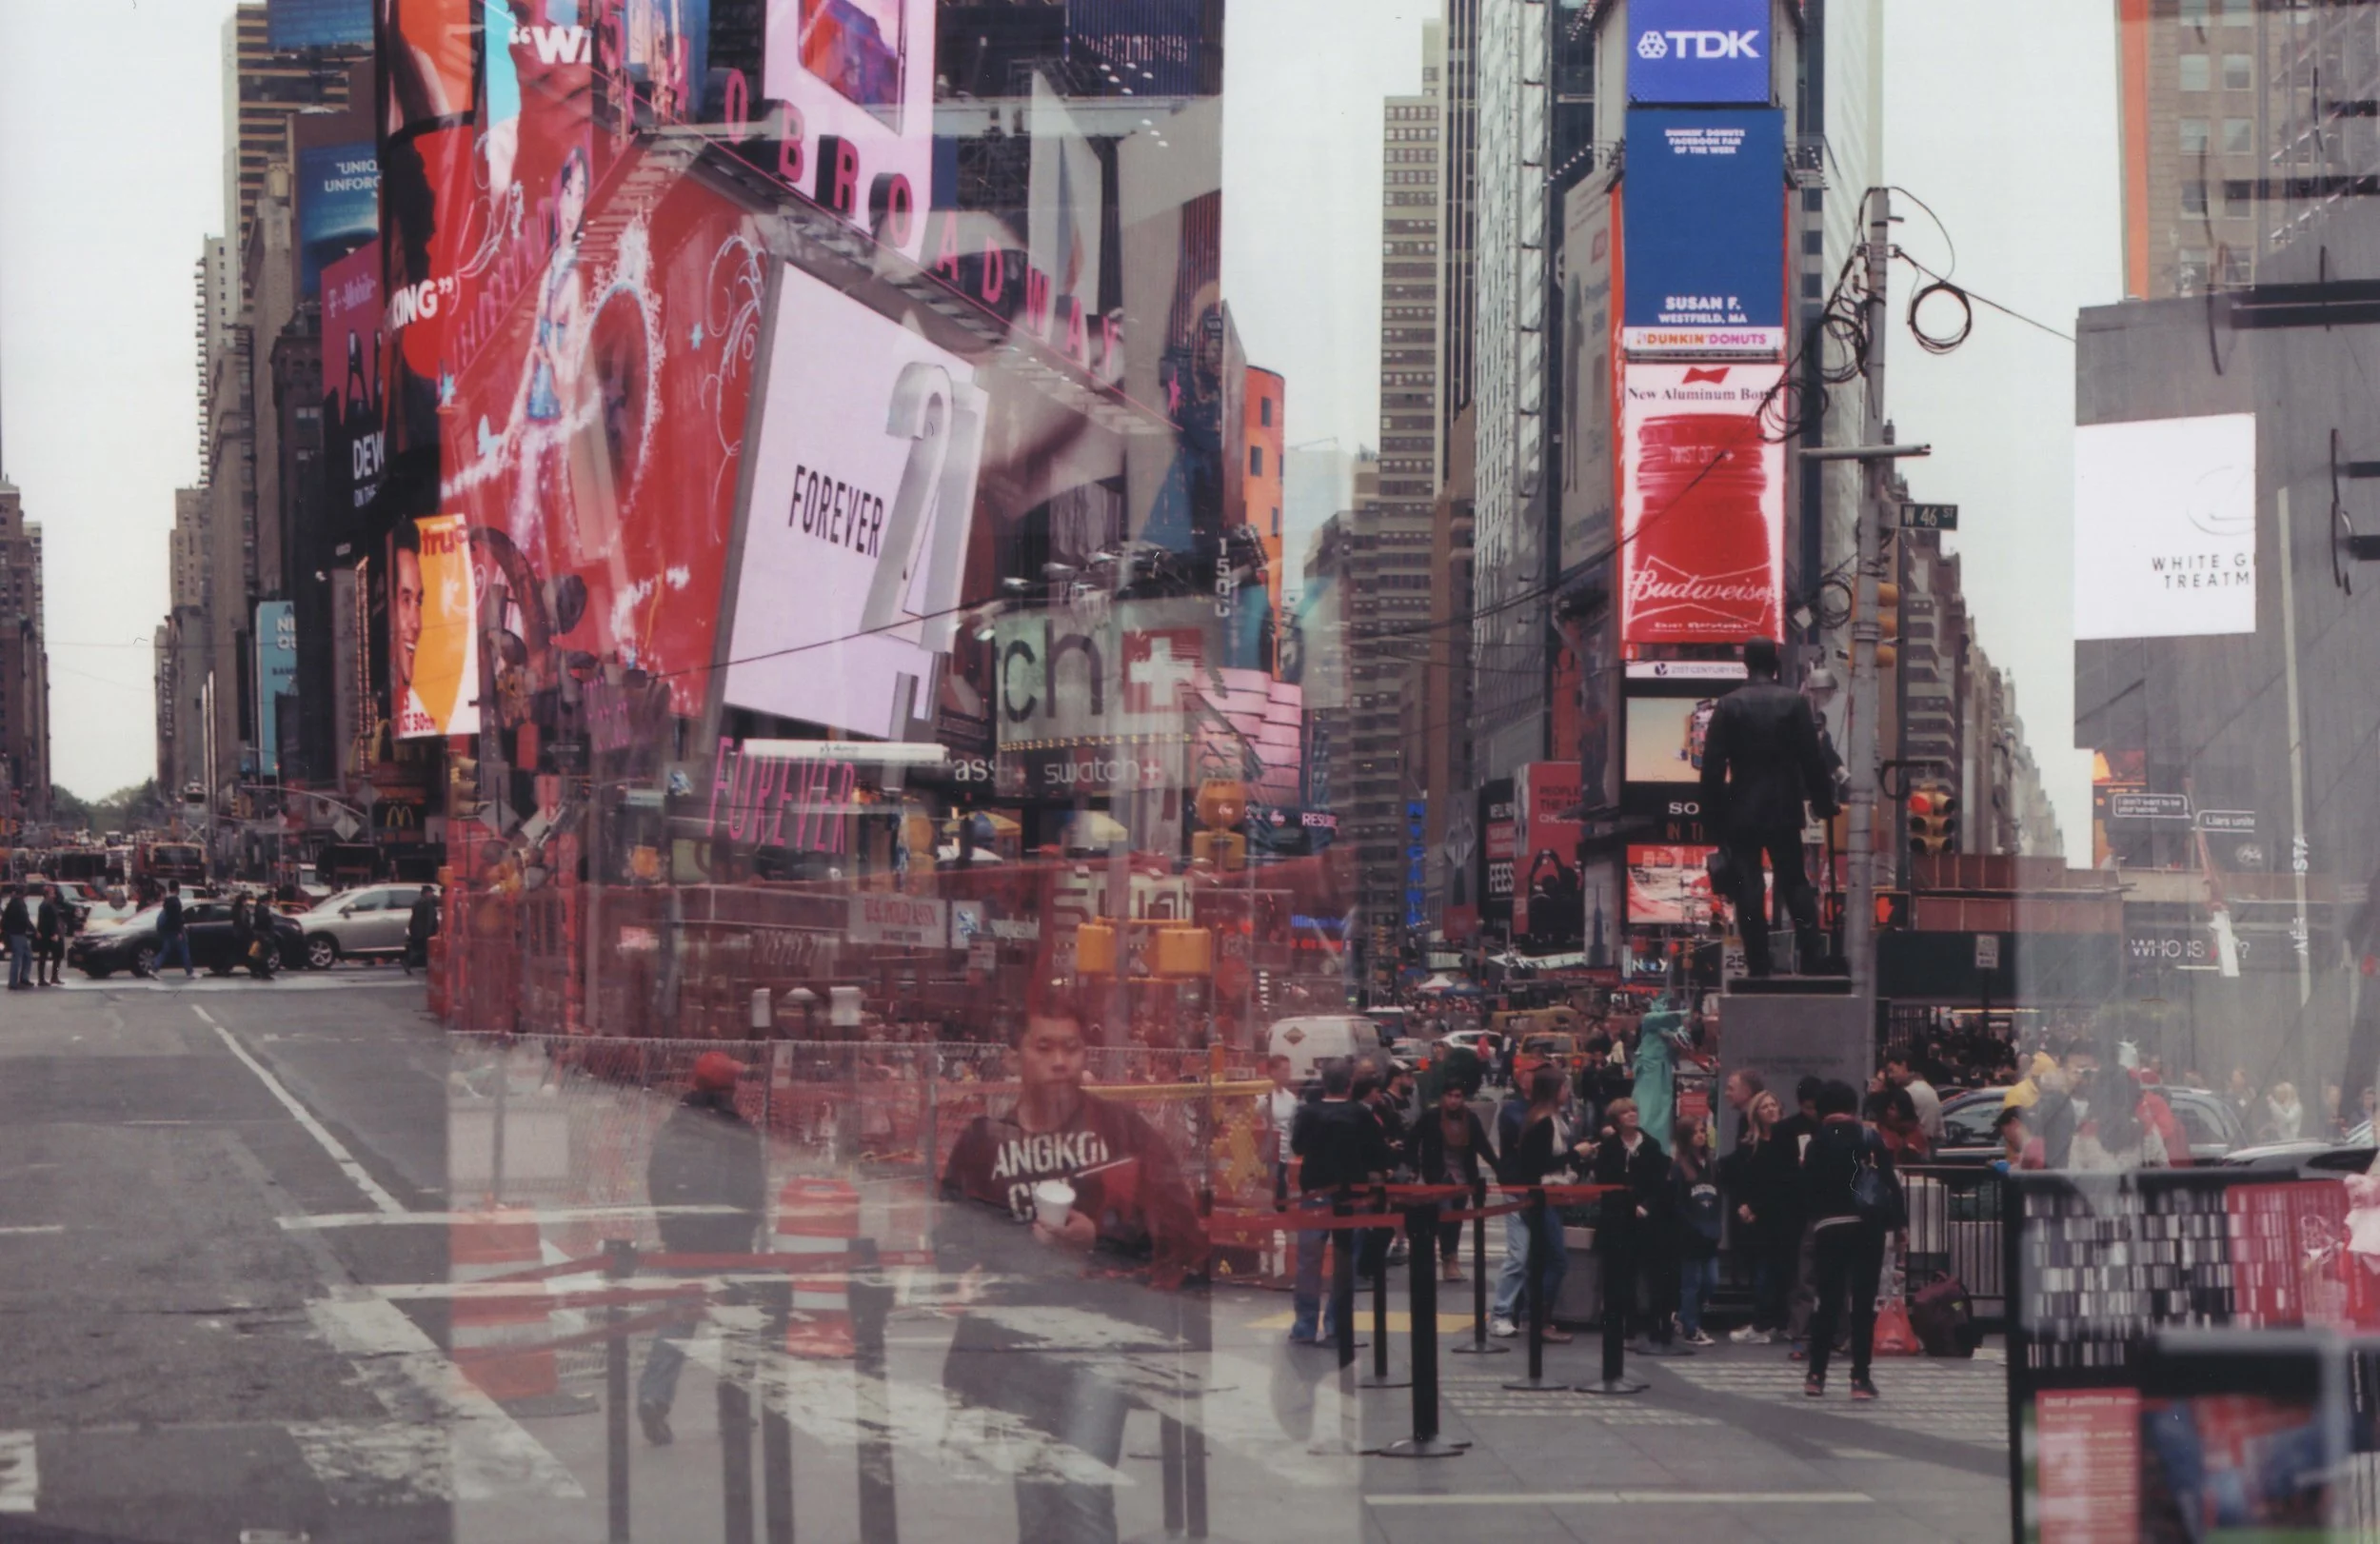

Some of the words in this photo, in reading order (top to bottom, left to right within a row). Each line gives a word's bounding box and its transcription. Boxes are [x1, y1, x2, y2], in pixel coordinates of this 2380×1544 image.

[1666, 30, 1760, 58] TDK
[1674, 146, 1686, 154] OF
[1689, 146, 1707, 154] THE
[1709, 146, 1736, 154] WEEK
[779, 98, 1121, 377] BROADWAY
[1665, 296, 1722, 310] SUSAN
[1727, 296, 1741, 310] F.
[1658, 313, 1725, 325] WESTFIELD,
[1728, 313, 1748, 324] MA
[1709, 334, 1767, 345] DONUTS
[1628, 387, 1656, 400] New
[1661, 387, 1735, 401] Aluminum
[788, 464, 884, 559] FOREVER
[1904, 506, 1915, 525] W
[1919, 506, 1937, 526] 46
[2152, 554, 2219, 571] WHITE
[2233, 552, 2248, 566] G
[1630, 569, 1776, 605] Budweiser
[2164, 571, 2250, 589] TREATM
[1043, 755, 1140, 784] swatch
[705, 736, 855, 855] FOREVER
[2131, 940, 2182, 958] WHO
[2187, 940, 2205, 958] IS
